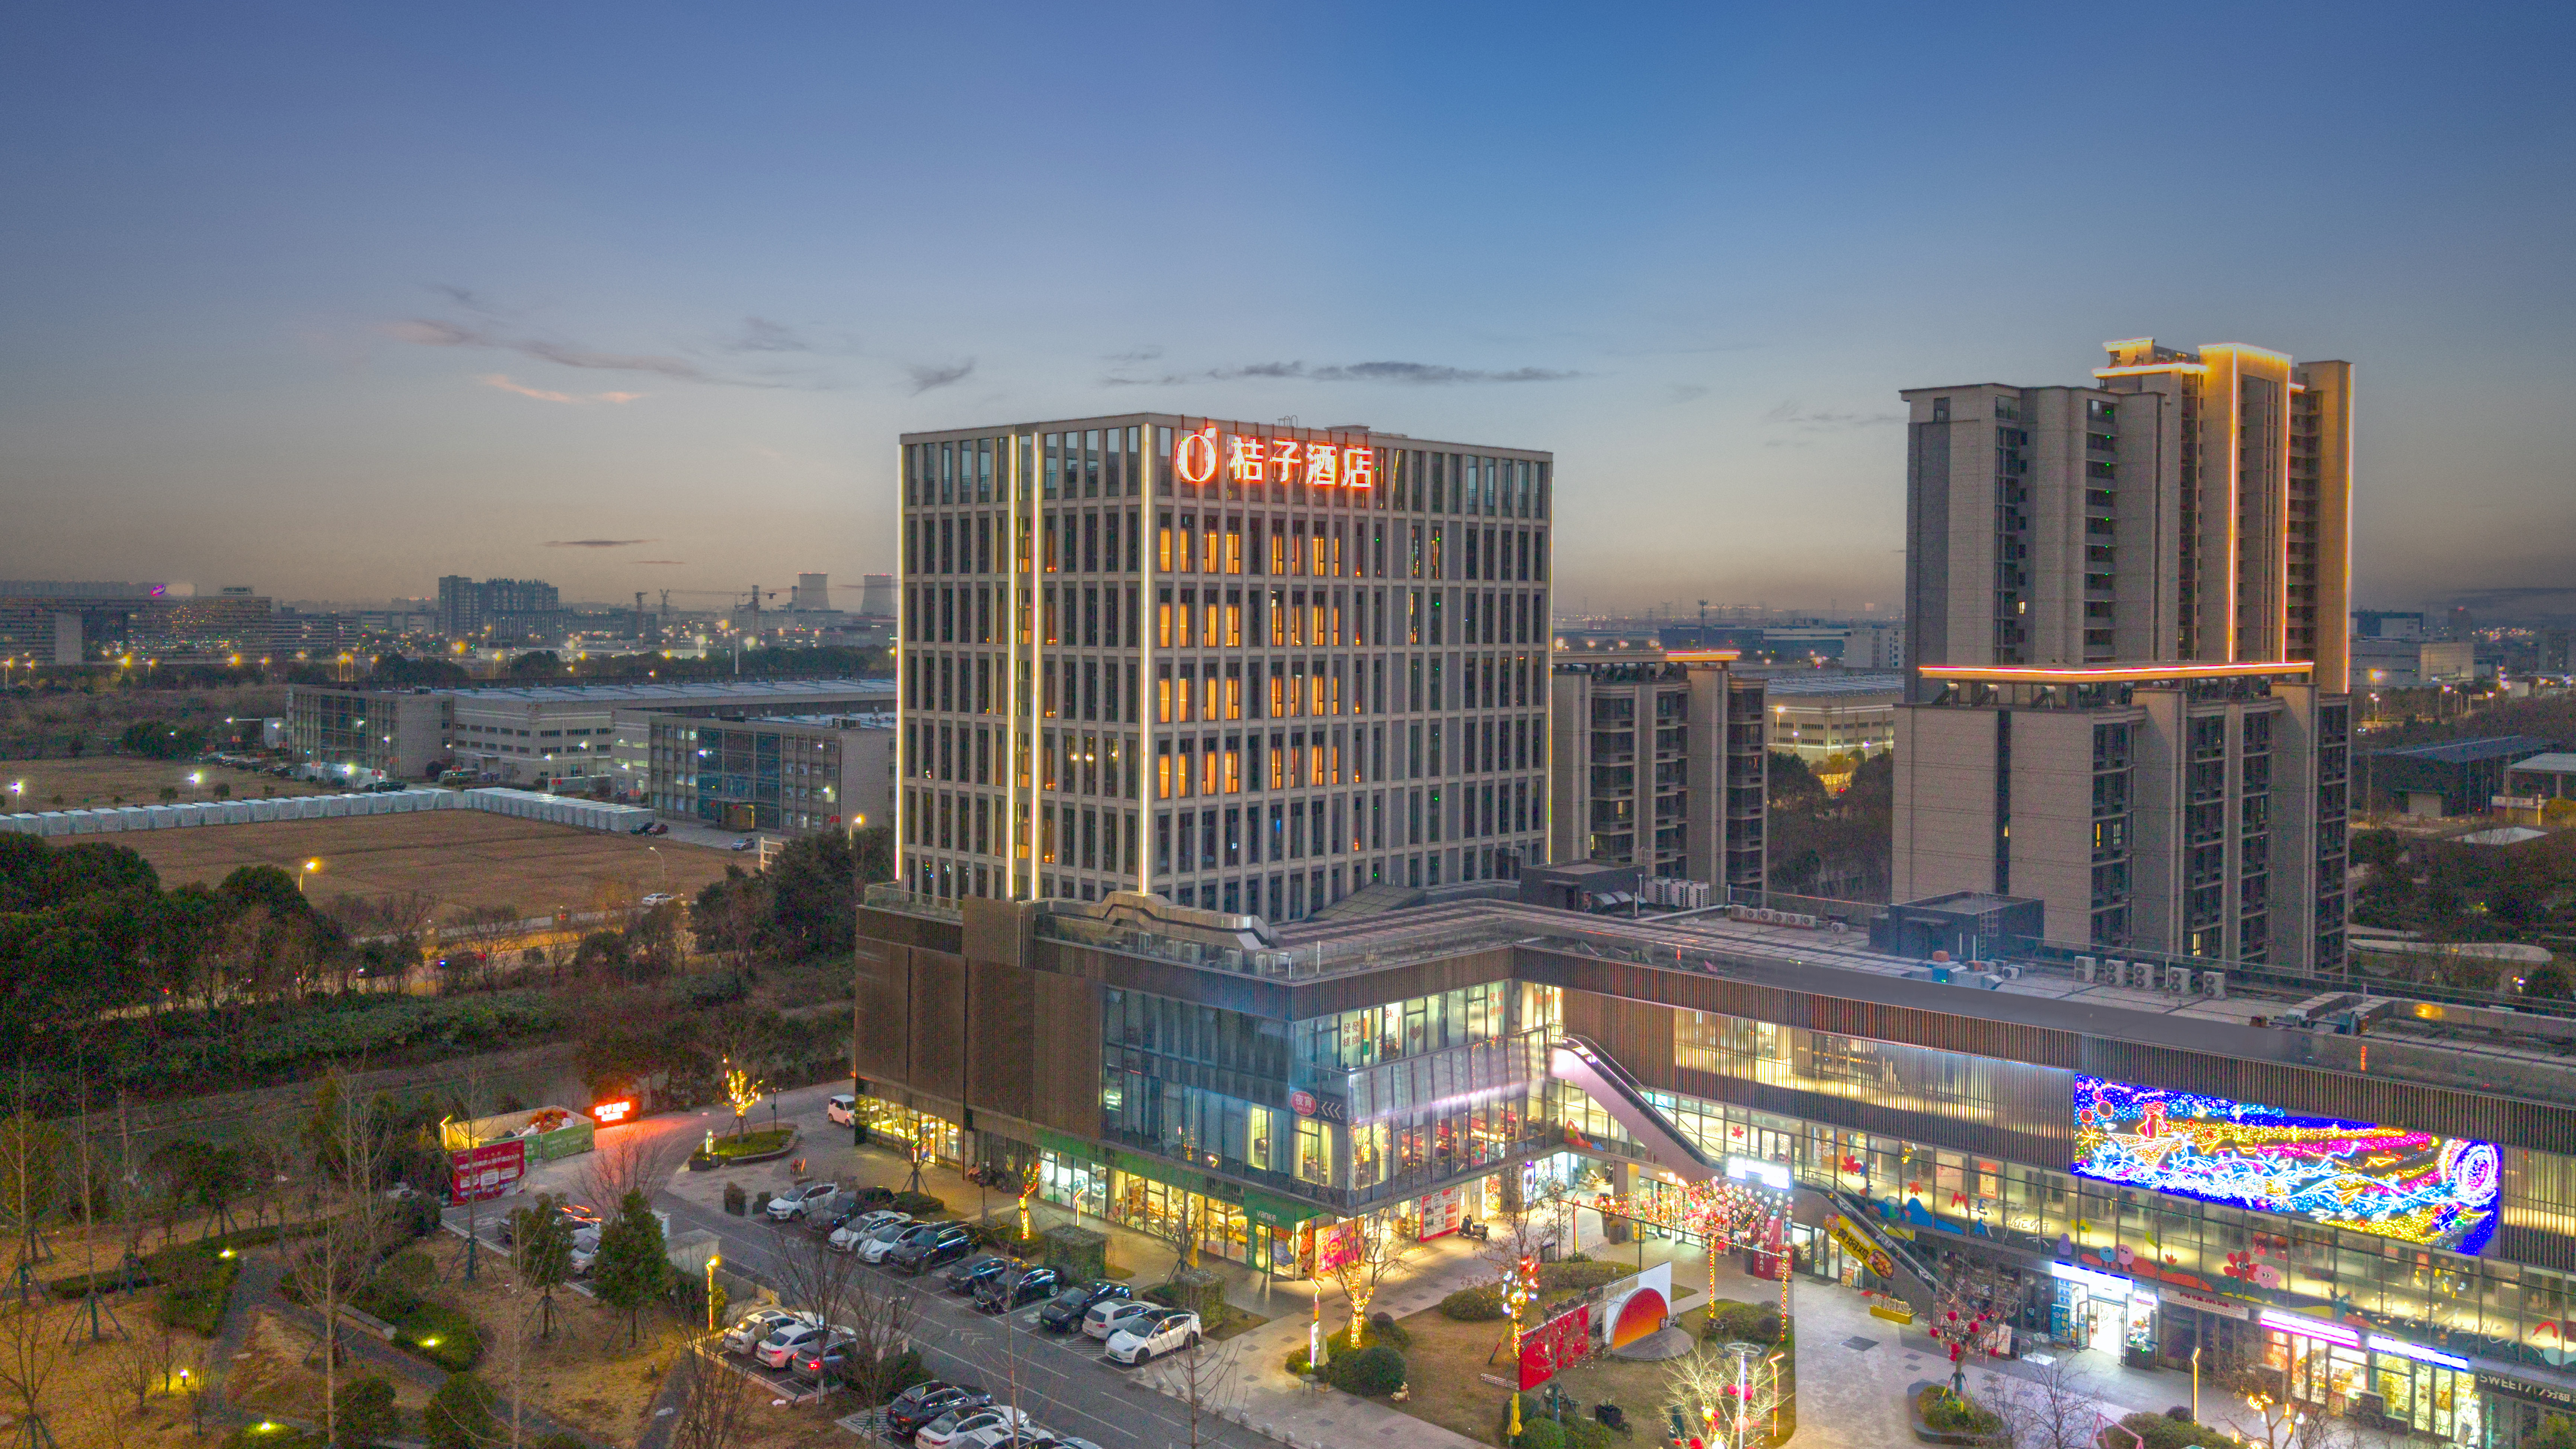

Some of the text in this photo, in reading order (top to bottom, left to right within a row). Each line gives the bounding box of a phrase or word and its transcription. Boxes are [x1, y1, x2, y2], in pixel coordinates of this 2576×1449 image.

[1230, 436, 1372, 488] 桔子酒店
[1295, 1094, 1312, 1108] 夜宵
[1836, 1228, 1869, 1260] 黄焖鸡
[1870, 1293, 1911, 1315] 黄焖鸡
